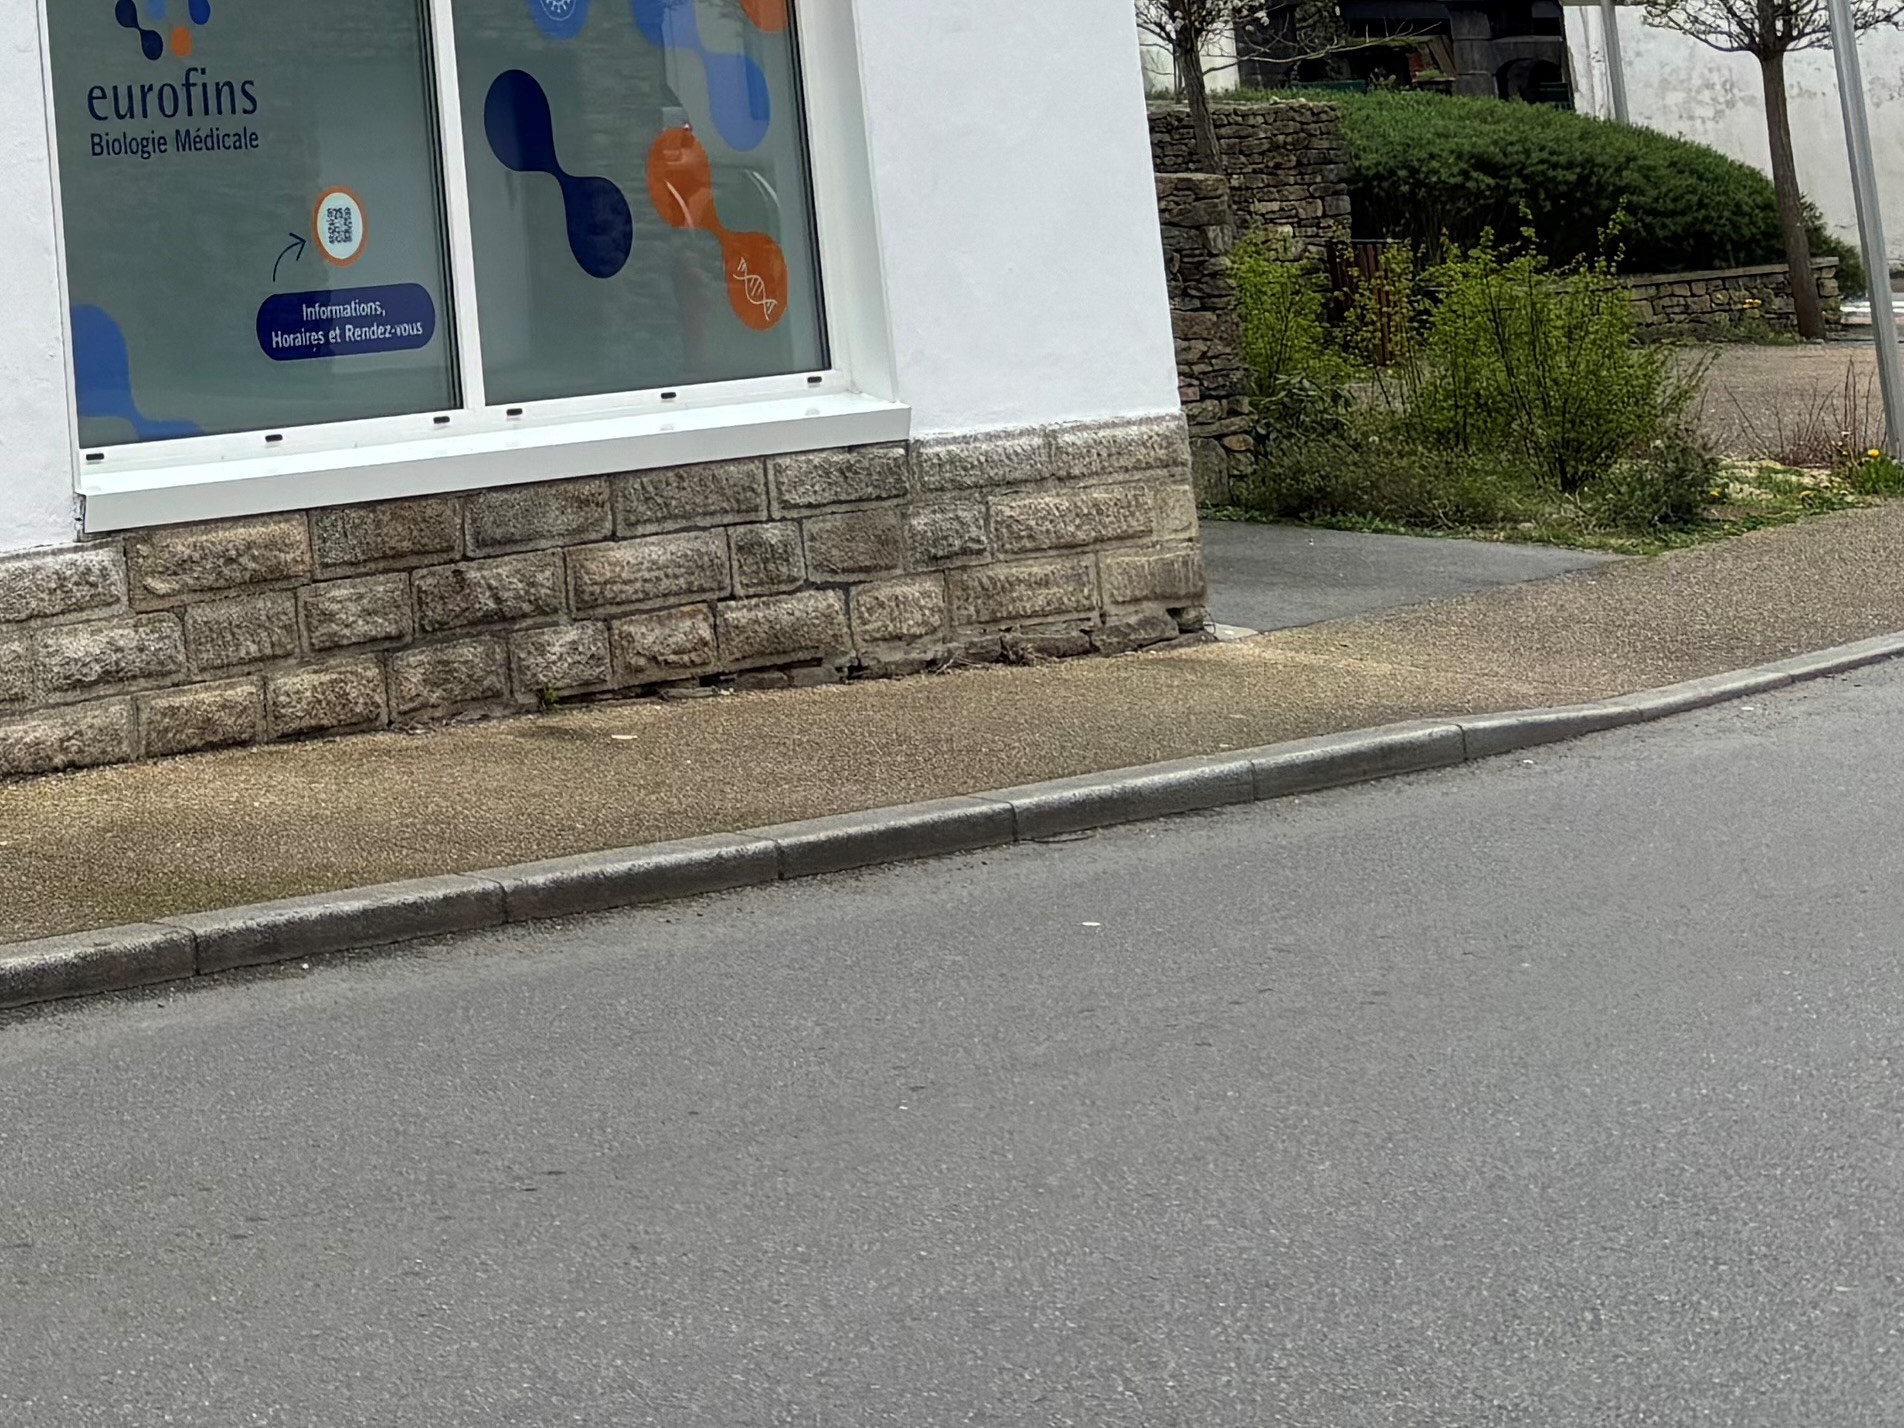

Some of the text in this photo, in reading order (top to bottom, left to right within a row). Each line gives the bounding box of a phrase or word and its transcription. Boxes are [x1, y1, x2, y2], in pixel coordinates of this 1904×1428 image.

[86, 66, 259, 122] eurofins
[89, 125, 260, 160] Biologie Médicale
[302, 299, 386, 321] Informations,
[272, 321, 424, 349] Horaires et Rendez-vous
